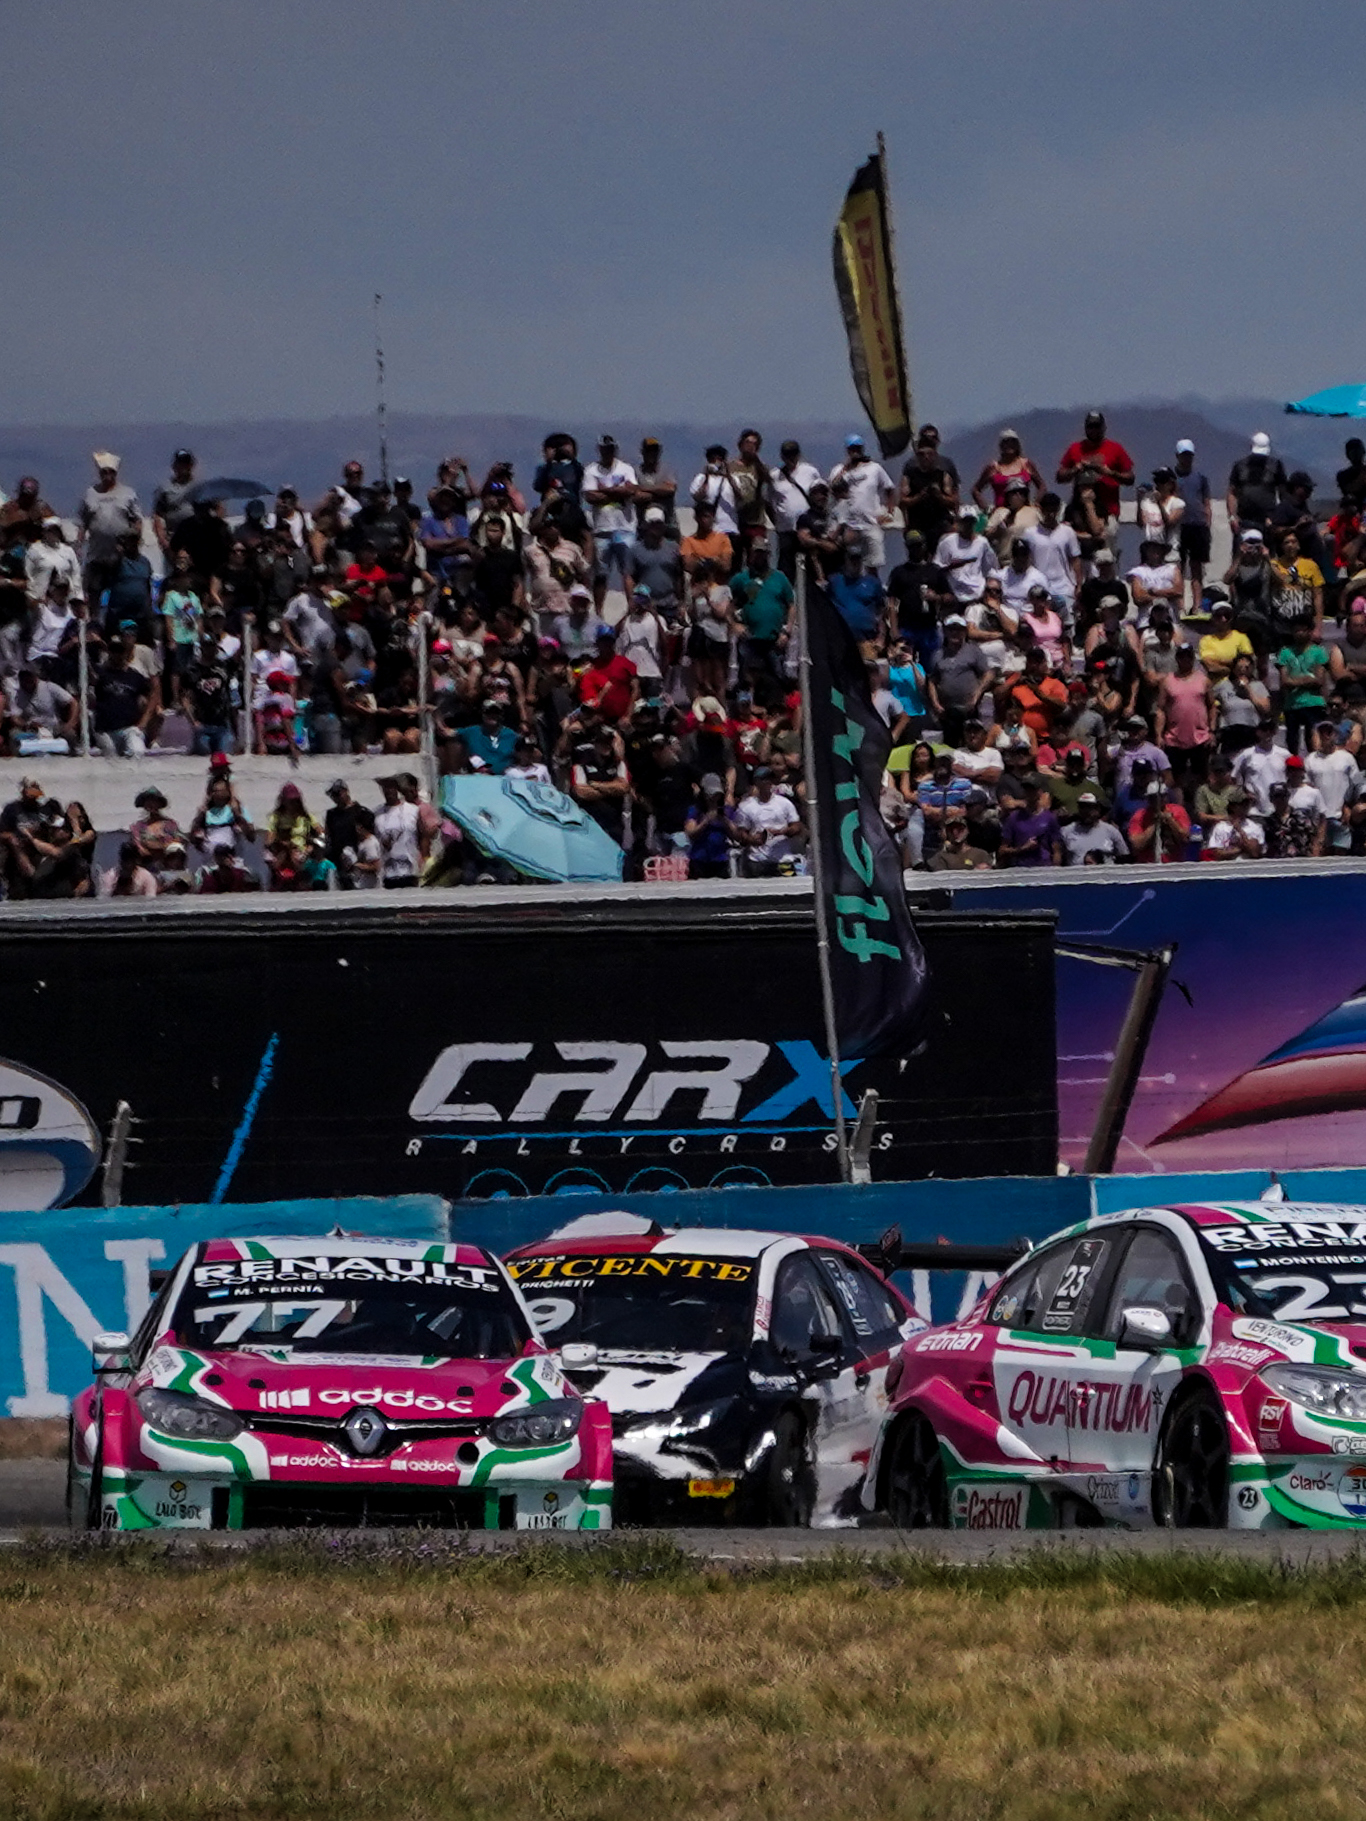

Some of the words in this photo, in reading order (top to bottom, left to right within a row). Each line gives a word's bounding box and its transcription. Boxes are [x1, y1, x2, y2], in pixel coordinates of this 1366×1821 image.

[831, 685, 901, 962] flow
[408, 1039, 865, 1122] CARX
[194, 1256, 499, 1284] RENAULT
[195, 1271, 500, 1293] CONCESIONARIOS
[507, 1258, 752, 1282] VICENTE
[1056, 1264, 1091, 1299] 23
[194, 1299, 350, 1345] 77
[318, 1386, 474, 1414] addoc
[290, 1455, 339, 1468] addoc
[408, 1459, 456, 1472] addoc
[1289, 1475, 1326, 1491] Claro
[967, 1489, 1023, 1531] Castrol
[1242, 1489, 1256, 1508] 23
